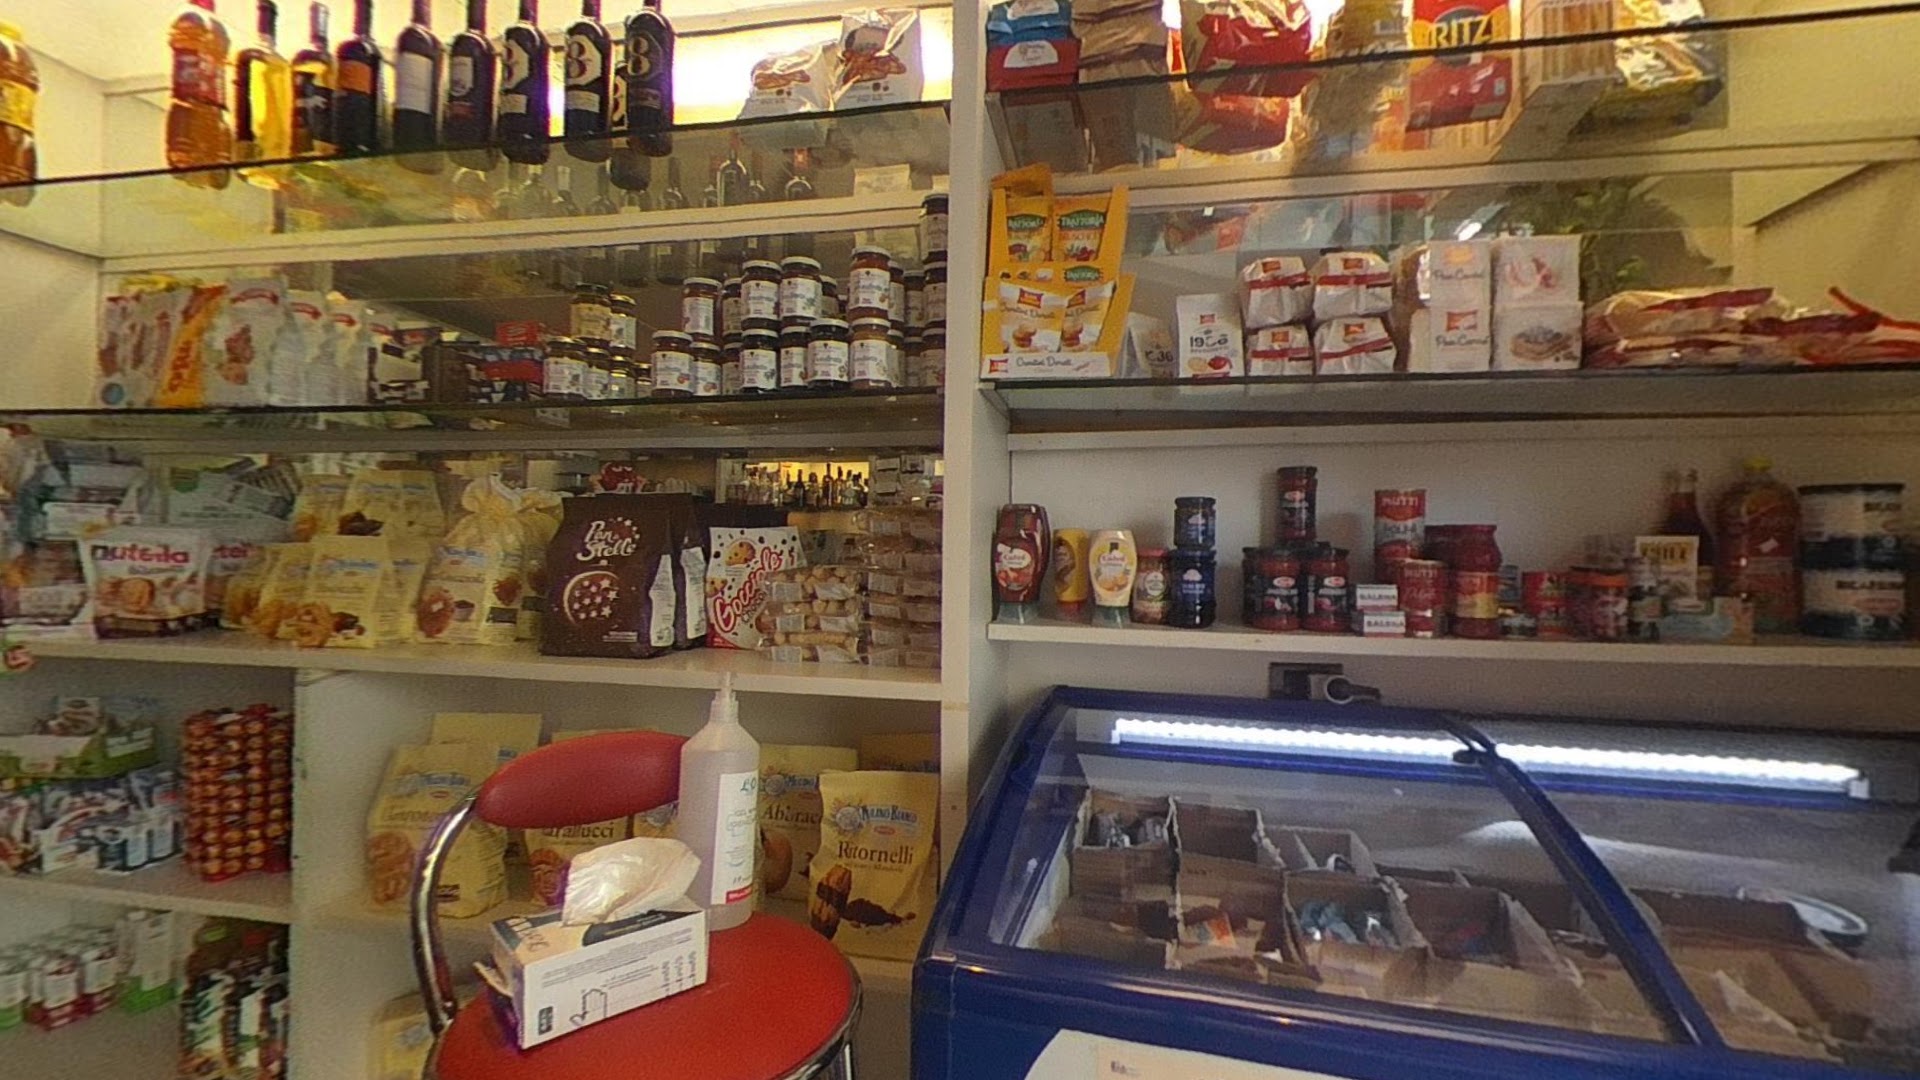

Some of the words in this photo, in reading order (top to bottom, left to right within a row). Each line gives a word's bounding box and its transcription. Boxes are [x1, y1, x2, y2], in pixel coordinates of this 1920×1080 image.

[1427, 14, 1494, 48] RITZ
[584, 520, 614, 543] Pan
[1366, 620, 1405, 629] BALENA
